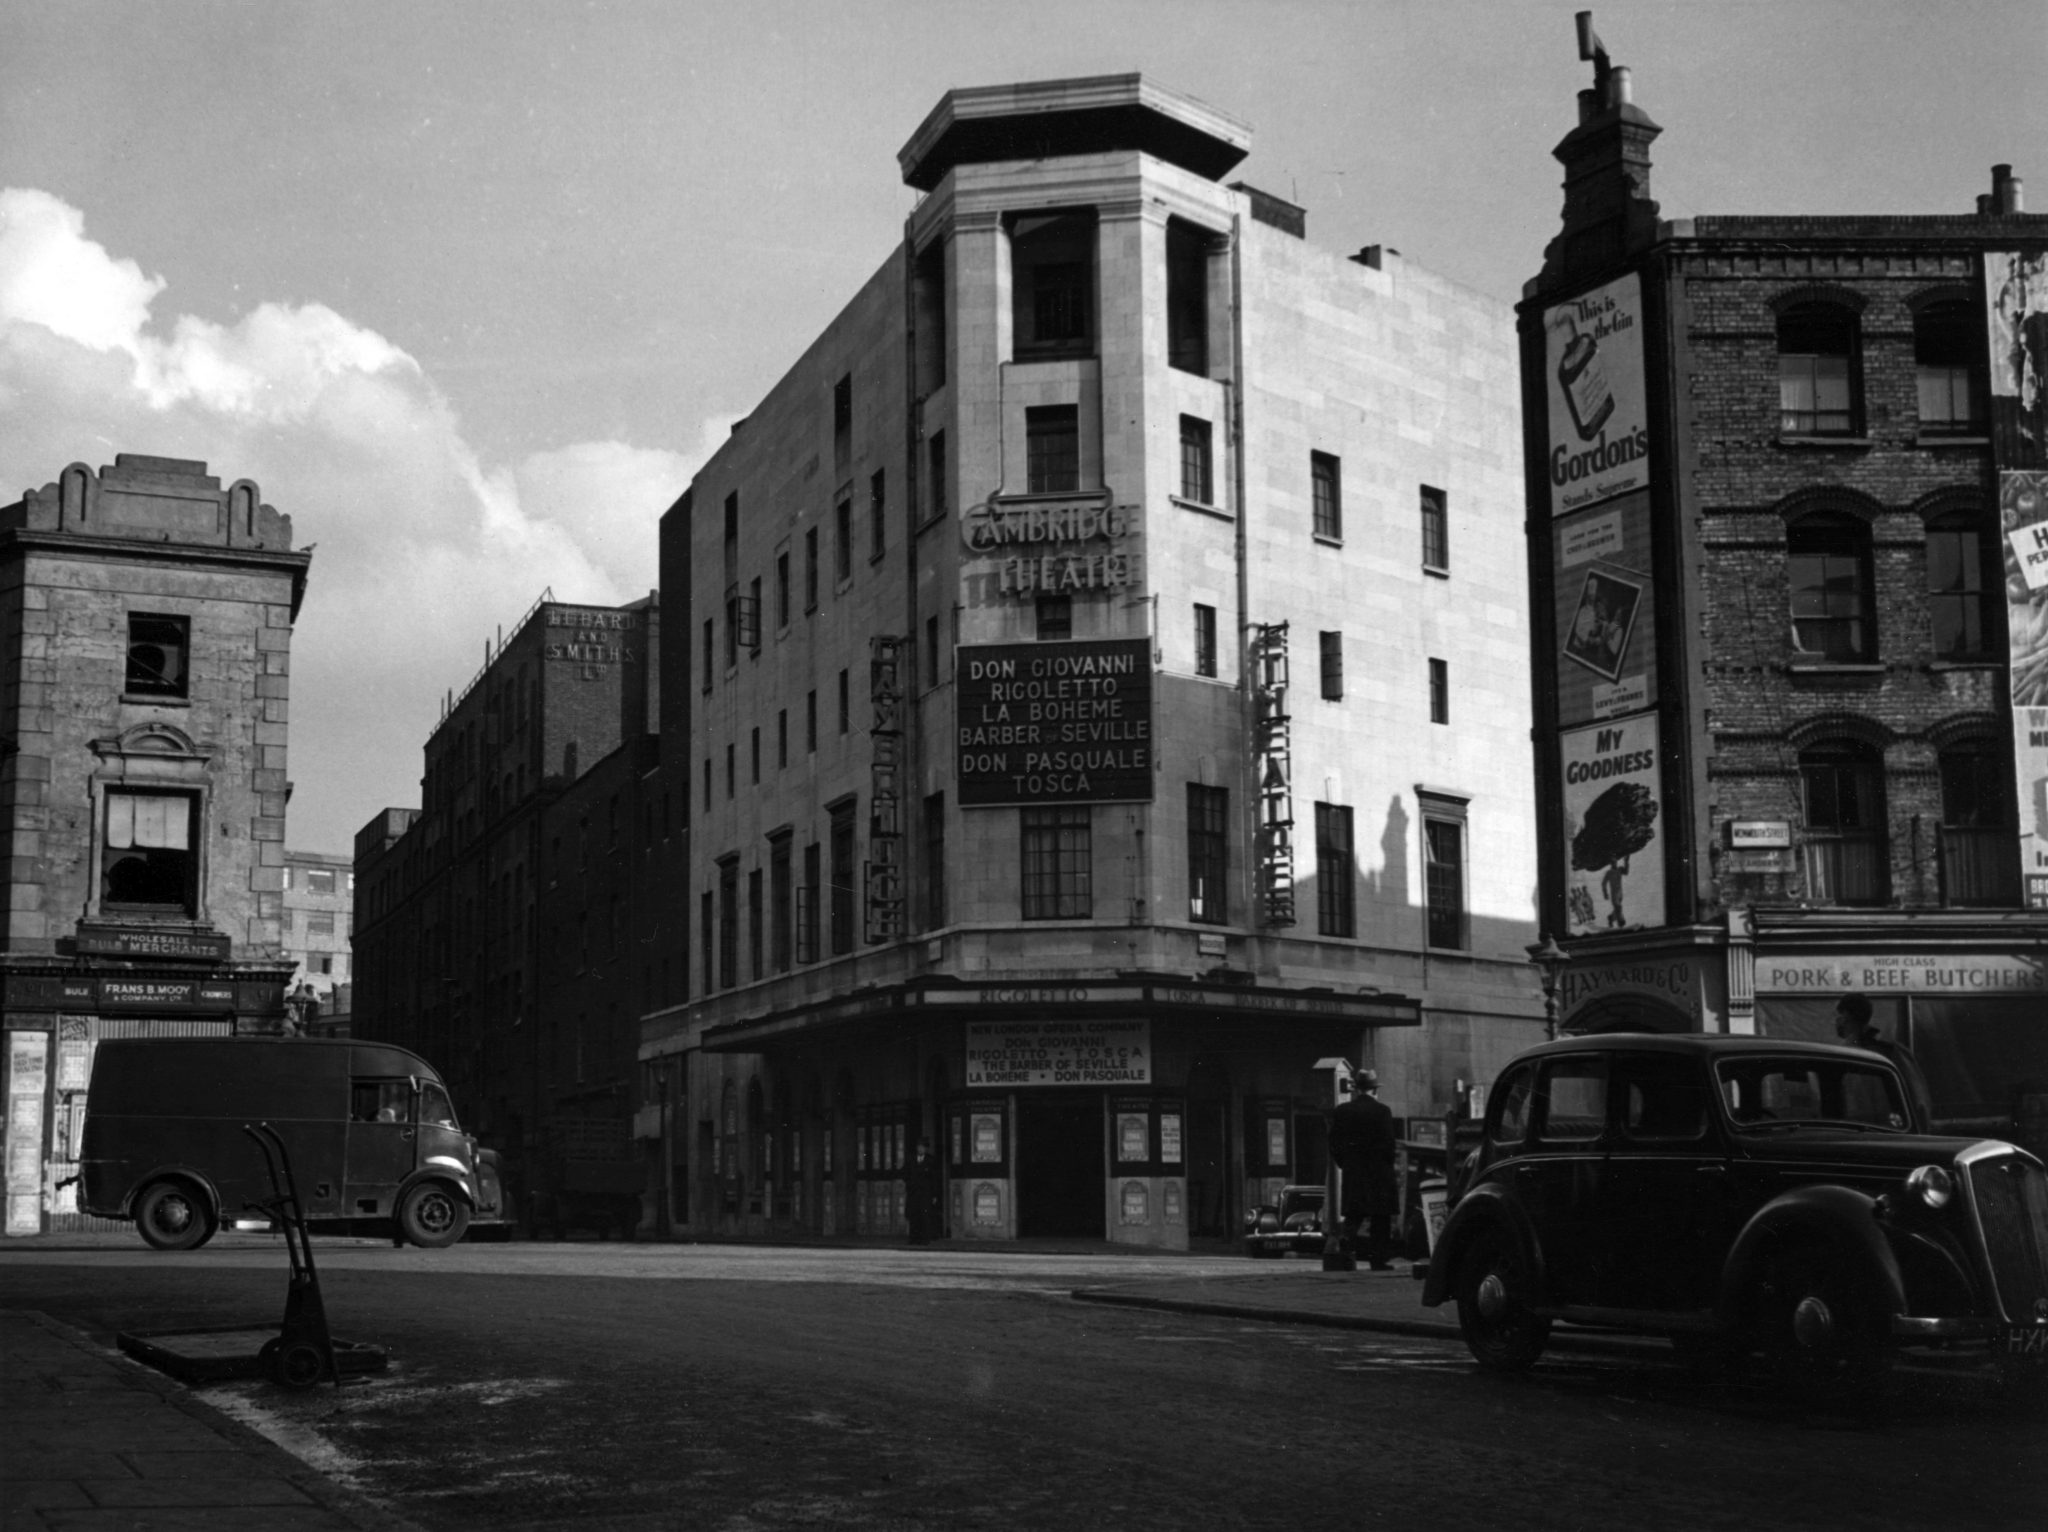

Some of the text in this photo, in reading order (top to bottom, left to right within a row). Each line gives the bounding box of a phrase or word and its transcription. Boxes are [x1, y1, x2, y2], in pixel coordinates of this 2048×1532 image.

[1563, 296, 1615, 322] This is
[1595, 309, 1633, 339] the Gin
[1551, 425, 1648, 486] Gordon's
[962, 504, 1140, 551] CAMBRIDGE
[995, 555, 1140, 591] THEATRE
[578, 631, 608, 642] AND
[551, 643, 634, 662] SMITHS
[970, 654, 1134, 680] DON GIOVANNI
[991, 678, 1117, 701] RIGOLETTO
[982, 699, 1123, 723] LA BOHEME
[960, 726, 1041, 746] BARBER
[1061, 720, 1148, 743] SEVILLE
[1596, 728, 1624, 754] MY
[962, 749, 1145, 773] DON PASQUALE
[1566, 750, 1654, 784] GOODNESS
[1012, 774, 1091, 794] TOSCA
[119, 934, 190, 945] WHOLESALE
[129, 941, 219, 956] MERCHANTS
[1874, 957, 1936, 967] HIGH CLASS
[1772, 968, 2044, 987] PORK & BEEF BUTCHERS
[105, 984, 144, 995] FRANS
[157, 984, 191, 995] MOOY
[980, 988, 1087, 1003] RIGOLETTO
[1167, 989, 1205, 1004] TOSCA
[1562, 966, 1654, 1010] HAYWARD
[971, 1022, 1144, 1035] NEW LONDON OPERA COMPANY
[1005, 1036, 1105, 1049] DON GIOVANNI
[969, 1047, 1142, 1061] RIGOLETTO TOSCA
[982, 1058, 1128, 1071] THE BARBER OF SEVILLE
[969, 1070, 1145, 1084] LA BOHEME DON PASQUALE
